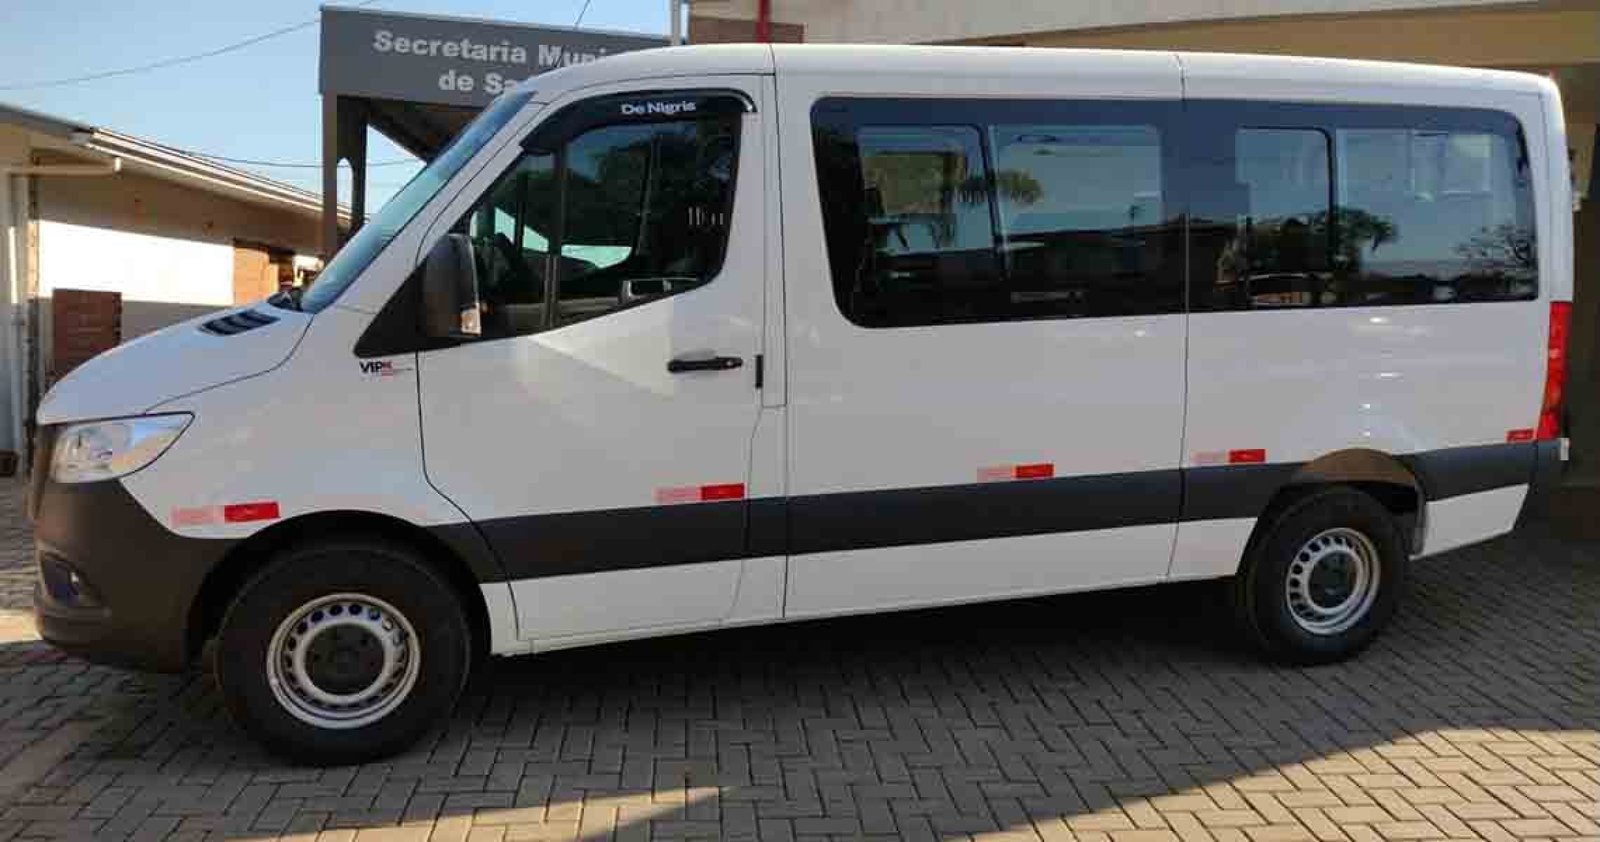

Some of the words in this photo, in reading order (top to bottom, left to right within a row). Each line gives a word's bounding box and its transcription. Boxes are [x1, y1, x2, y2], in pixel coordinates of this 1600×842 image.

[372, 29, 527, 64] Secretaria
[437, 69, 474, 92] de
[621, 103, 646, 115] De
[646, 100, 697, 115] Nigris
